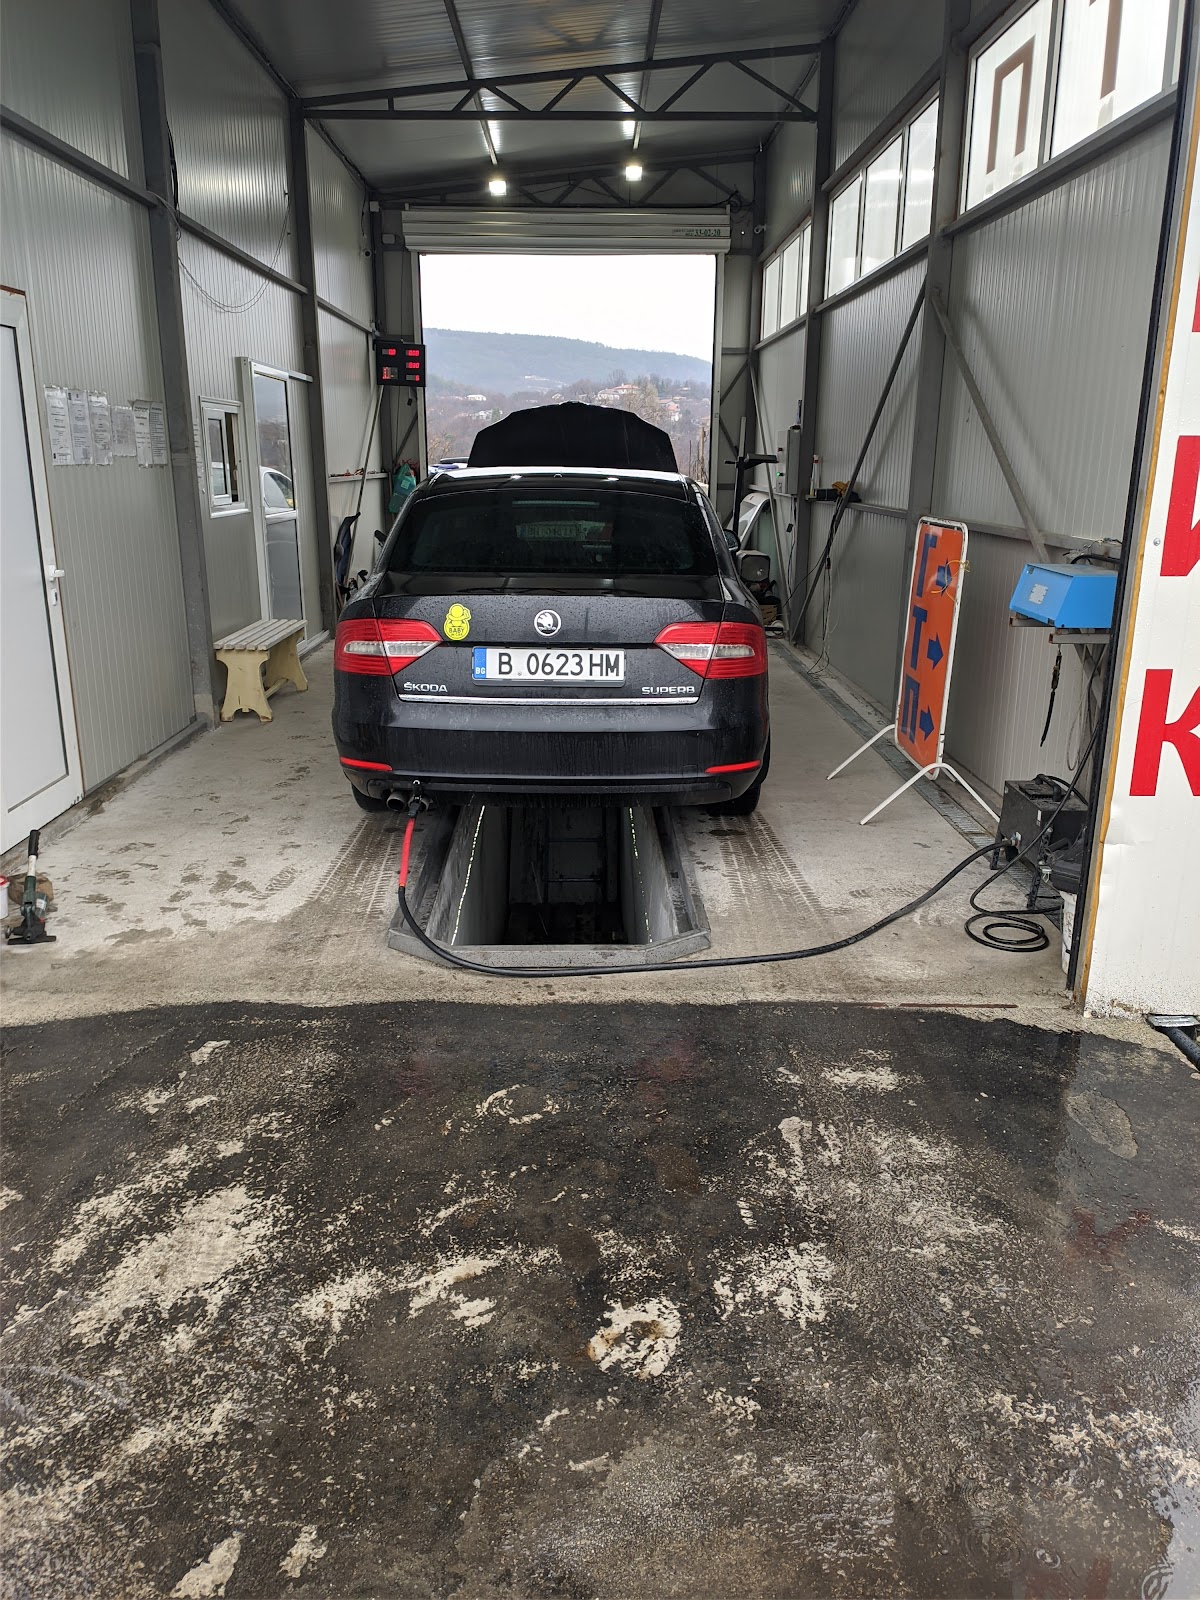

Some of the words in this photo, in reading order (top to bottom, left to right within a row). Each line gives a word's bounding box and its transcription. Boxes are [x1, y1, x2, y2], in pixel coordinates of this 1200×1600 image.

[475, 667, 486, 675] BG
[403, 681, 448, 693] ŠKODA
[641, 686, 696, 695] SUPERB
